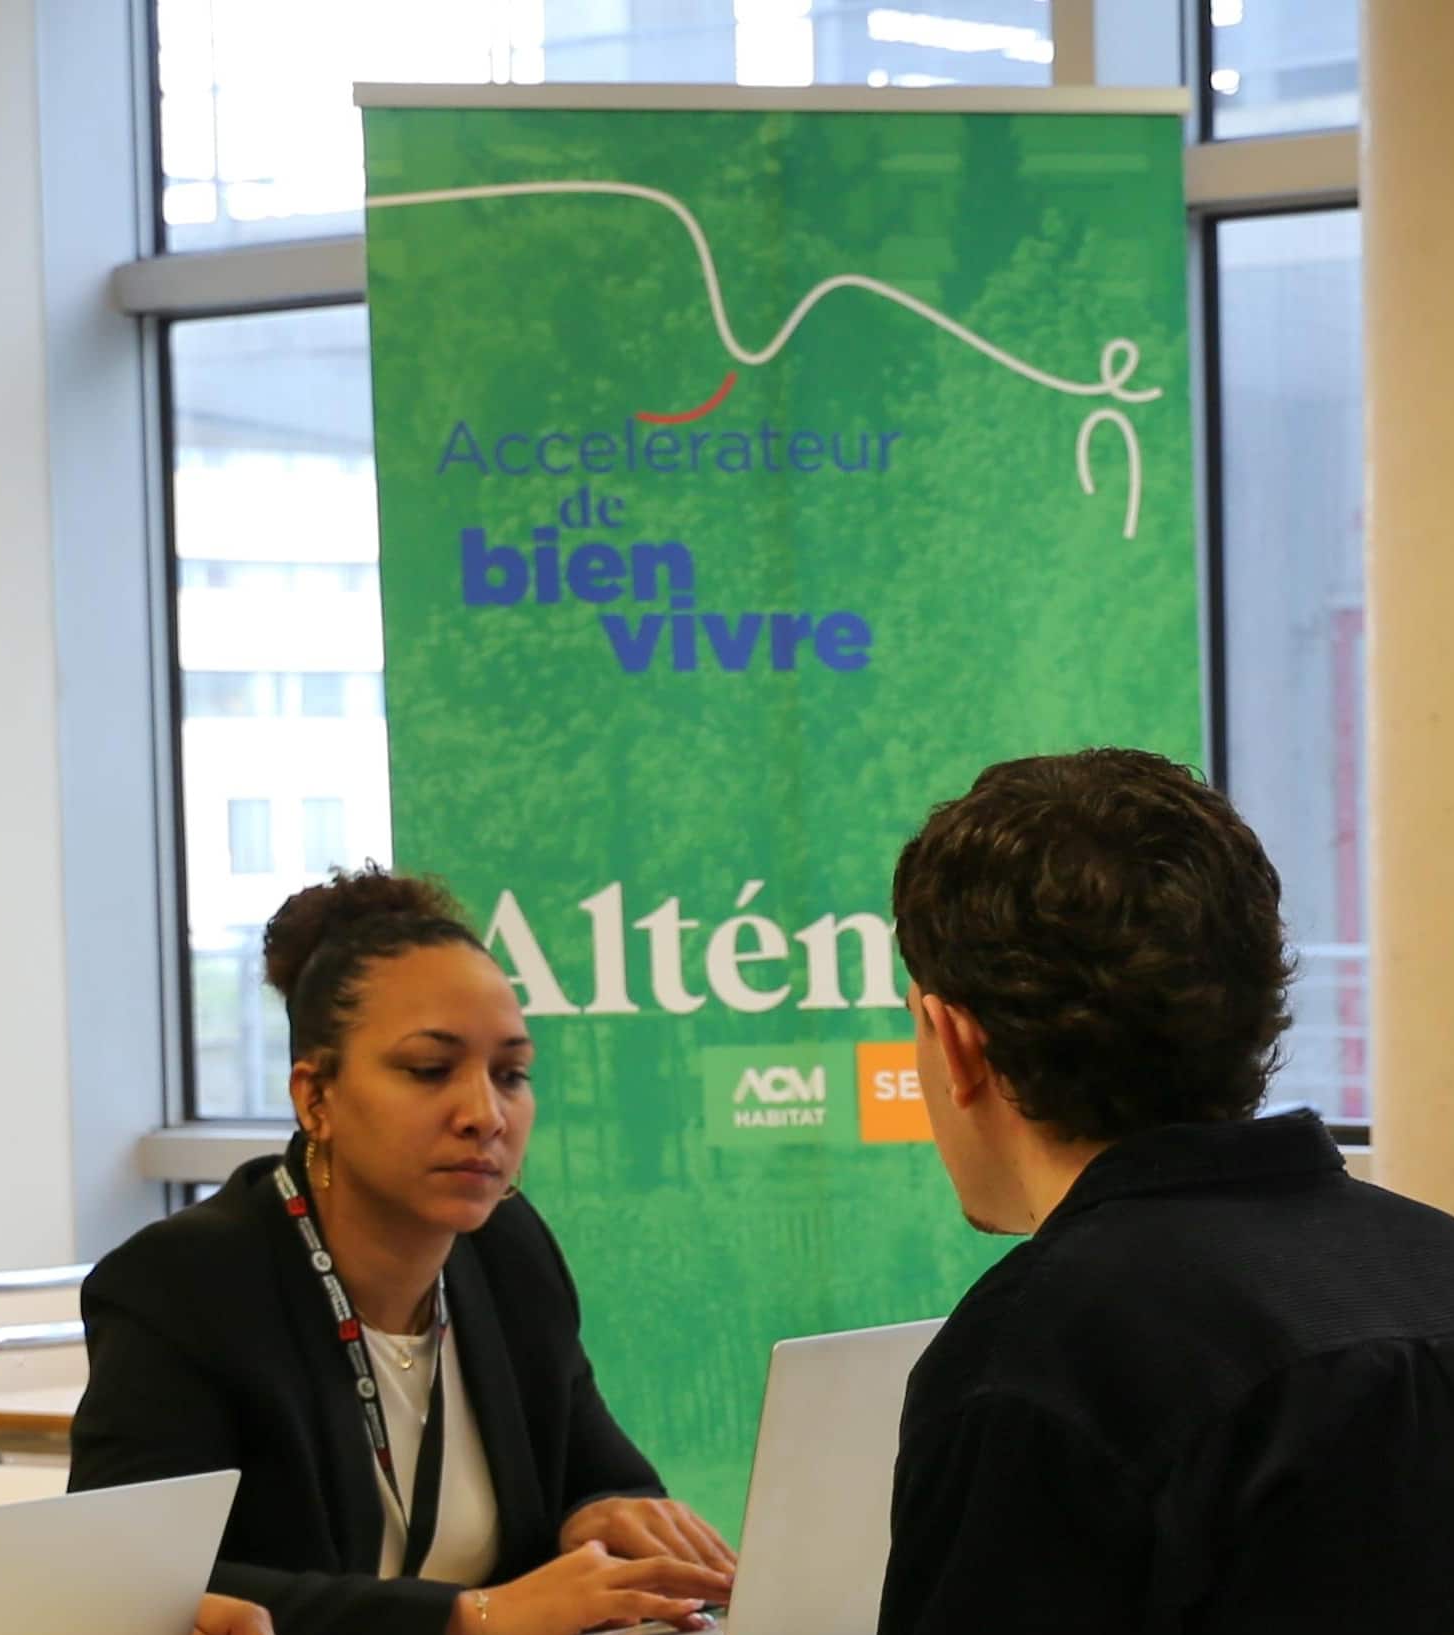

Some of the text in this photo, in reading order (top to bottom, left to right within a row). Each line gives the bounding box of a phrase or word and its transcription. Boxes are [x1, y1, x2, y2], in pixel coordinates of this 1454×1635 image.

[558, 484, 627, 530] de
[460, 526, 695, 607] bien
[598, 596, 874, 674] vivre
[482, 878, 910, 1017] Altém
[873, 1069, 924, 1102] SE
[733, 1107, 826, 1128] HABITAT
